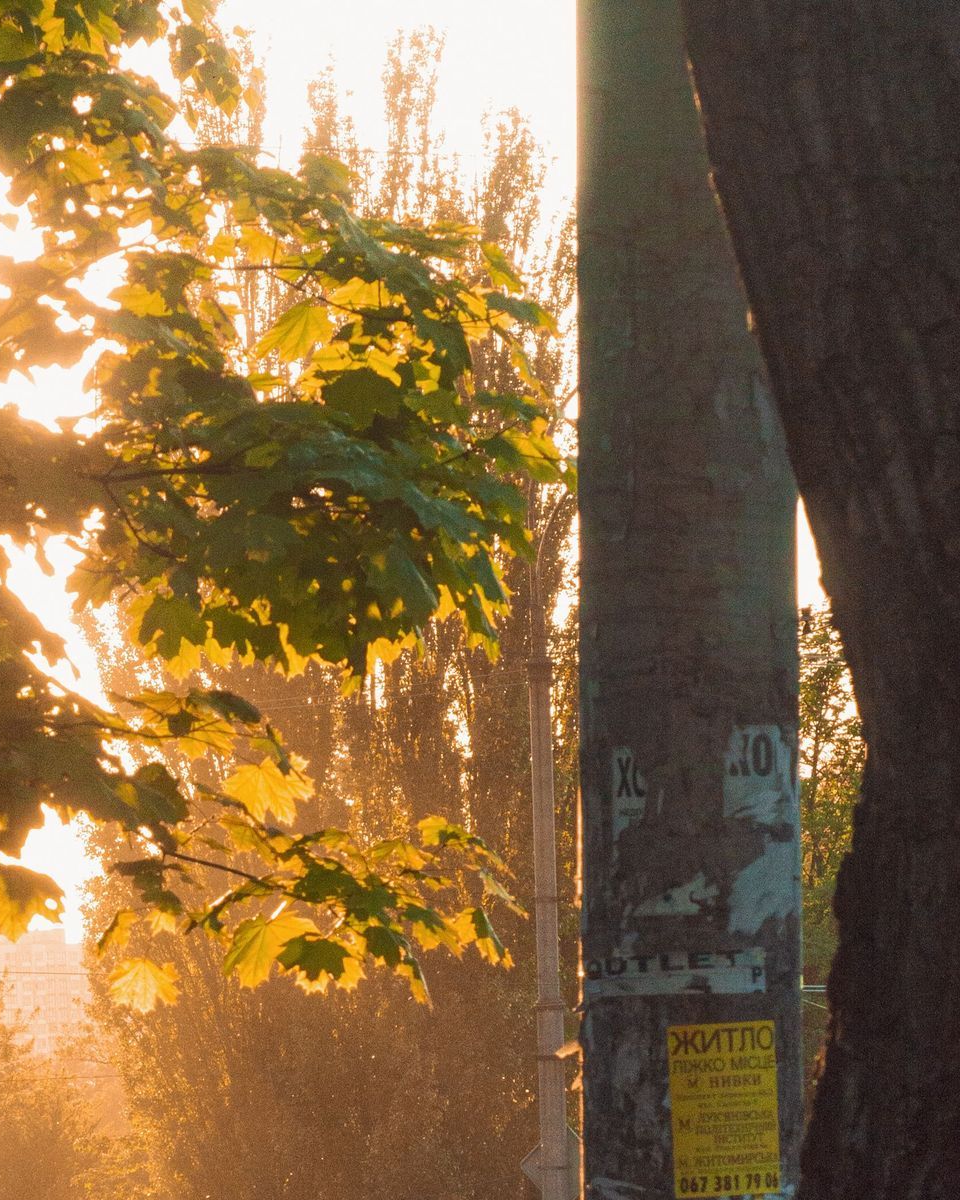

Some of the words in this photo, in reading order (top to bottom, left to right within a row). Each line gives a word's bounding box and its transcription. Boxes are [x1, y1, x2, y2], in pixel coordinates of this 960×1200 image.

[670, 1025, 774, 1055] ЖИТЛО
[672, 1058, 726, 1074] ЛІЖКО
[731, 1054, 776, 1071] МІСЦЕ
[709, 1074, 761, 1088] НИВКИ
[680, 1175, 708, 1193] 067
[714, 1174, 739, 1191] 381
[746, 1173, 761, 1189] 79
